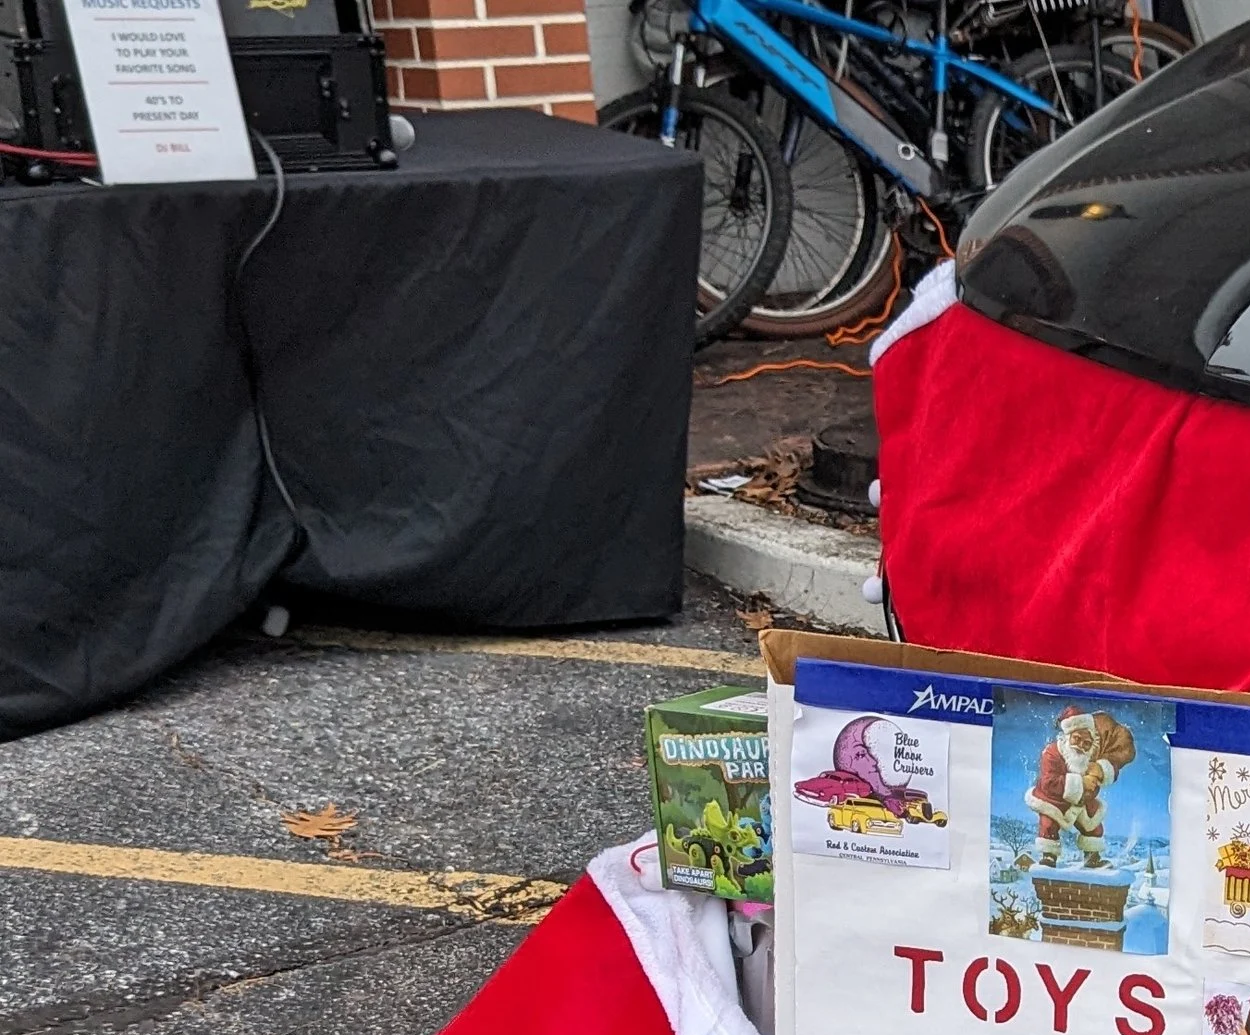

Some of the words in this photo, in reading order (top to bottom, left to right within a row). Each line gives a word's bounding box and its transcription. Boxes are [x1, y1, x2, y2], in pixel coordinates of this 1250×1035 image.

[118, 32, 158, 42] WOULD
[160, 32, 186, 42] LOVE
[117, 48, 130, 57] TO
[159, 48, 189, 57] YOUR
[115, 64, 164, 73] FAVORITE
[166, 64, 197, 73] SONG
[132, 111, 177, 121] PRESENT
[894, 732, 920, 748] Blue
[894, 747, 923, 762] Moon
[725, 761, 769, 779] PAR
[893, 760, 934, 777] Cruisers
[879, 845, 920, 859] Association
[672, 866, 690, 876] TAKE
[691, 868, 714, 879] APART
